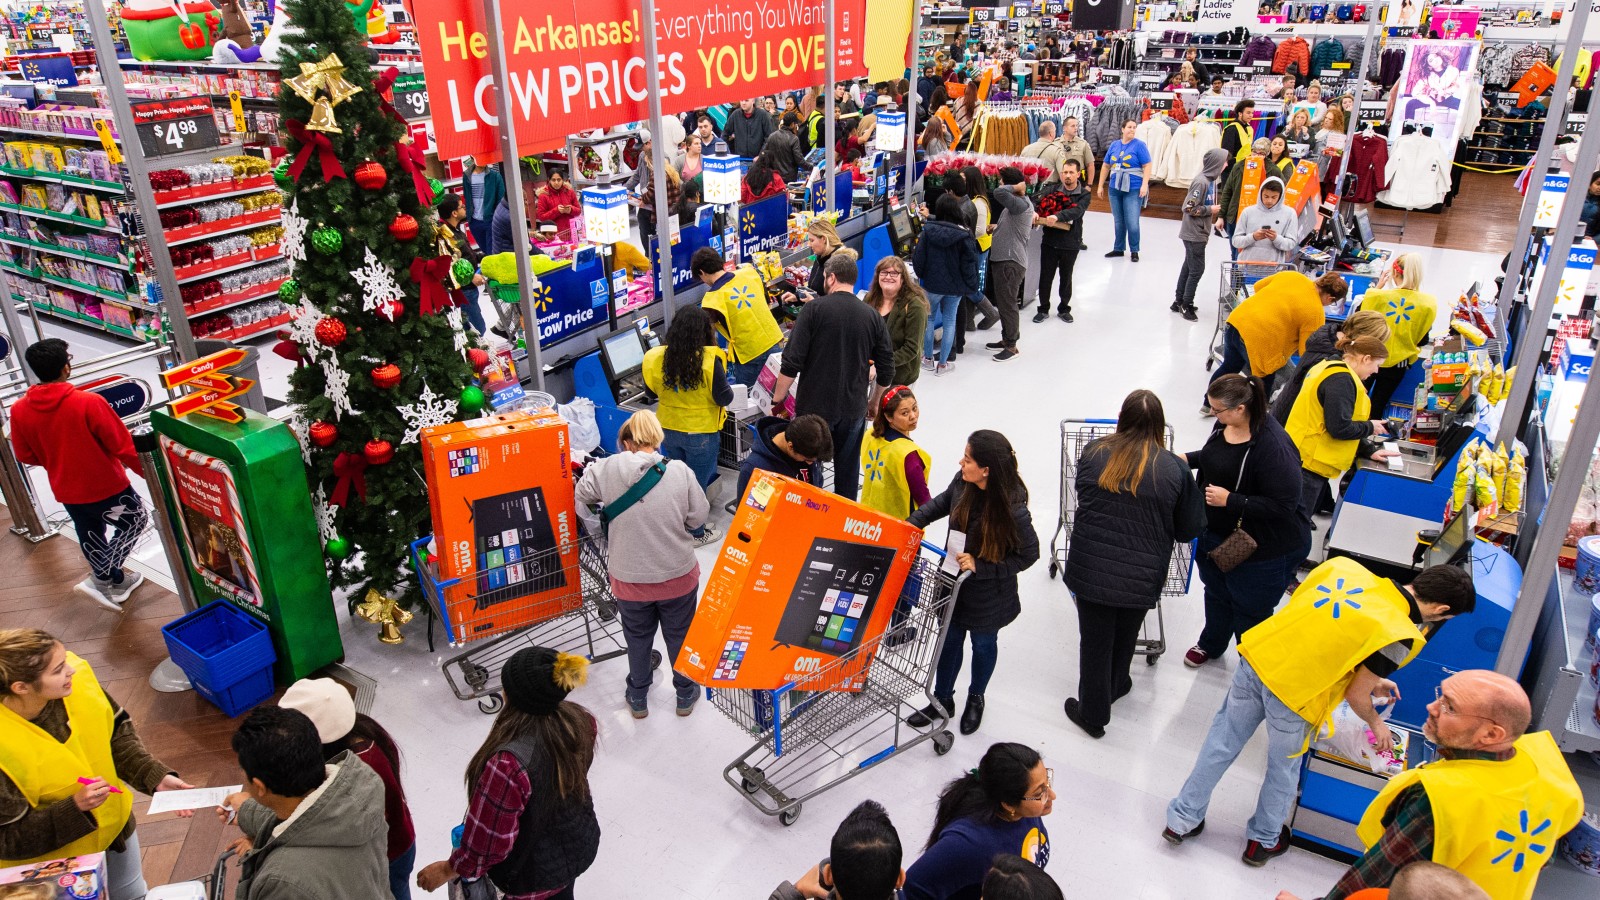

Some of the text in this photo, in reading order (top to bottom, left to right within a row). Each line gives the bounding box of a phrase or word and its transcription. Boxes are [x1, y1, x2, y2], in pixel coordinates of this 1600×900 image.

[975, 10, 989, 20] $69
[1046, 5, 1063, 14] $199
[1201, 10, 1232, 19] Active
[654, 0, 826, 44] Everything You Want
[438, 9, 641, 61] He Arkansas!
[697, 34, 825, 89] YOU LOVE
[447, 51, 687, 133] LOW PRICES
[135, 109, 154, 118] Happy
[153, 107, 170, 116] Price.
[169, 105, 186, 114] Happy
[877, 116, 896, 124] Scan&Go
[153, 119, 198, 149] $498
[105, 145, 113, 153] H
[703, 161, 725, 170] Scan&Go
[583, 194, 606, 205] Scan&Go
[606, 193, 628, 205] Scan&Go
[743, 234, 760, 245] Everyday
[743, 234, 780, 257] Low Price
[680, 267, 693, 280] Pri
[537, 310, 560, 325] Everyday
[537, 307, 594, 340] Low Price
[190, 361, 214, 374] Candy
[201, 392, 219, 402] Toys
[500, 392, 507, 401] 2
[513, 385, 523, 395] $5
[115, 395, 136, 408] your
[176, 466, 221, 494] Two ways to talk
[561, 469, 568, 479] TV
[180, 479, 187, 488] to
[186, 481, 197, 493] the
[197, 486, 207, 500] big
[206, 492, 222, 505] man!
[785, 491, 802, 505] onn.
[805, 498, 830, 513] Roku TV
[558, 510, 574, 556] watch
[744, 522, 754, 531] 4K
[843, 516, 883, 542] watch
[459, 540, 472, 573] onn.
[726, 546, 748, 563] onn.
[902, 550, 913, 563] 4K
[204, 577, 271, 622] Days until Christmas
[816, 615, 828, 626] HBO
[794, 656, 822, 673] onn.
